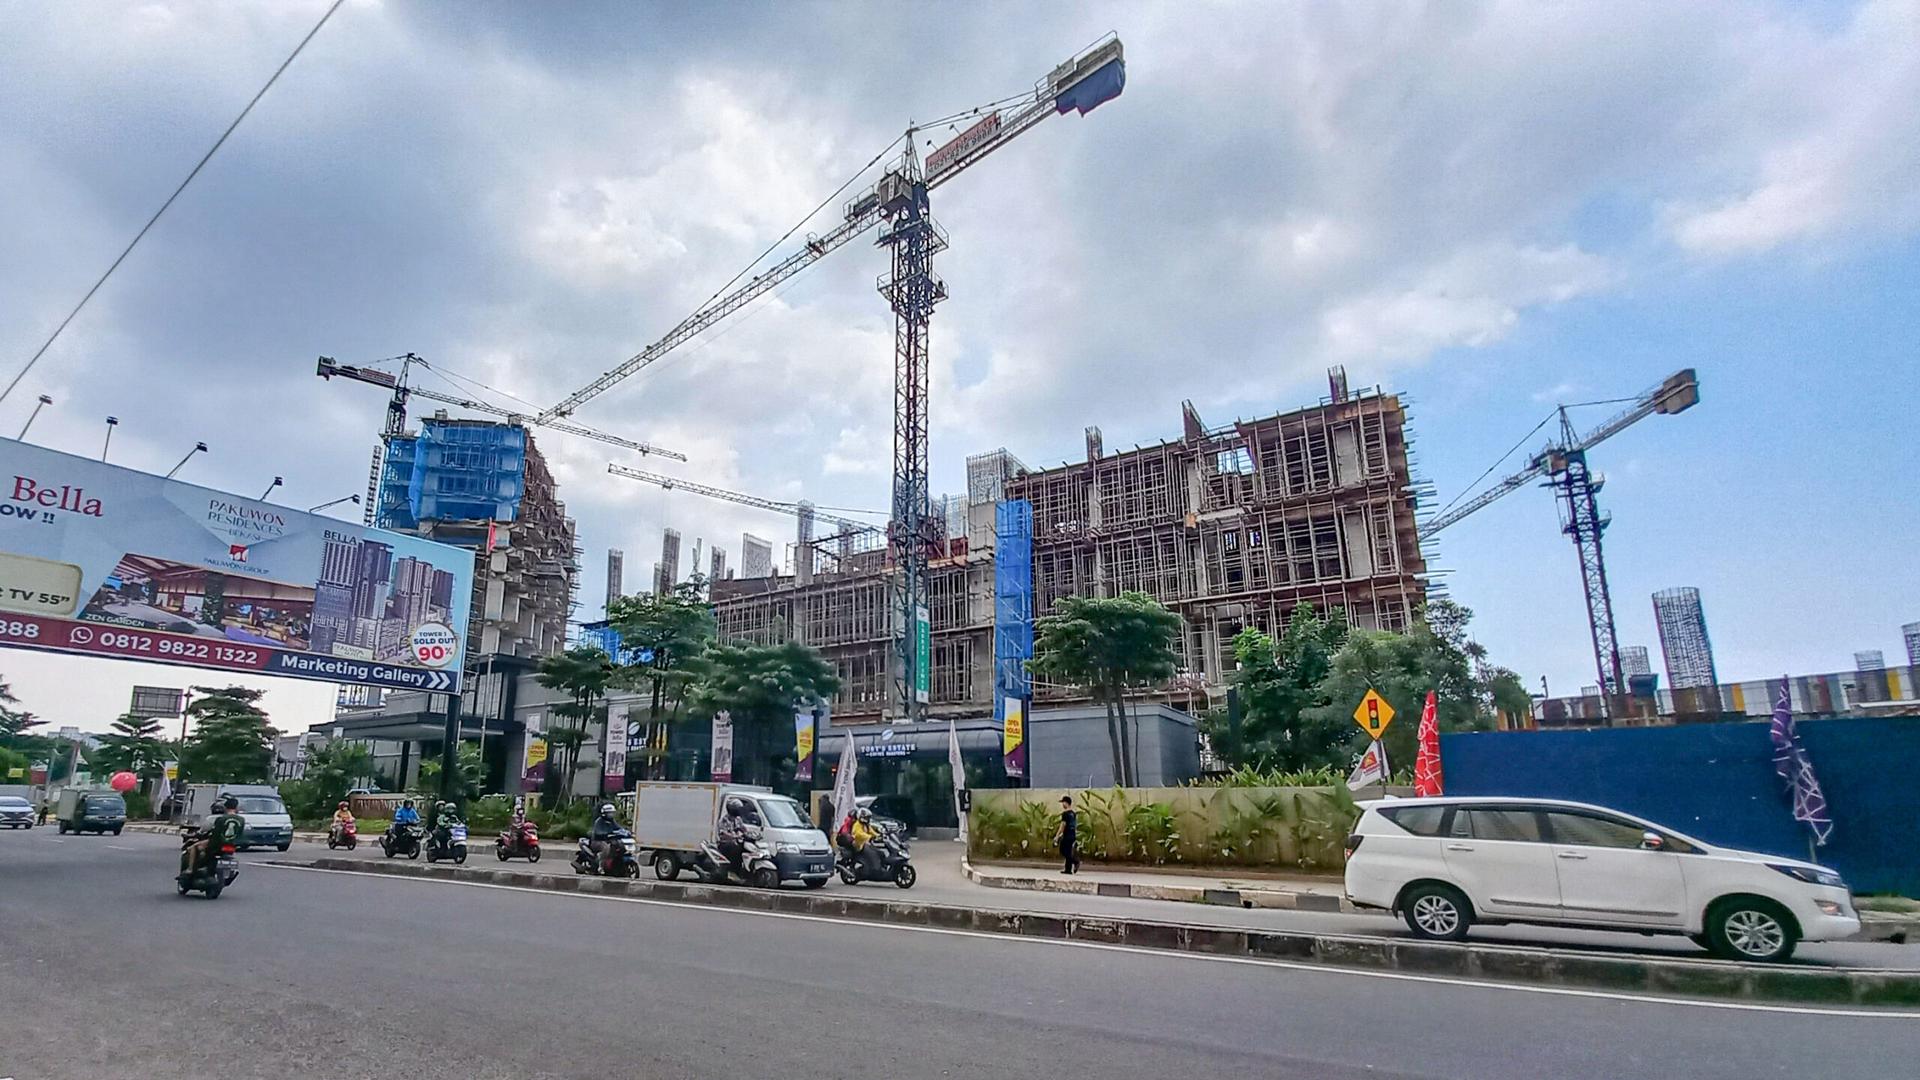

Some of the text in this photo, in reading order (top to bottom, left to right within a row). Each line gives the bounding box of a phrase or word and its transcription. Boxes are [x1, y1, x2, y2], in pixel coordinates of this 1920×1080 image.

[9, 475, 104, 517] Bella
[209, 499, 284, 526] PAKUWON
[208, 511, 283, 535] RESIDENCES
[324, 529, 357, 545] BELLA
[9, 588, 34, 601] TV
[86, 613, 145, 628] ZEN GARDEN
[100, 632, 257, 664] 0812 9822 1322
[438, 637, 455, 645] OUT
[281, 654, 426, 686] Marketing Gallery
[887, 743, 916, 751] ESTATE
